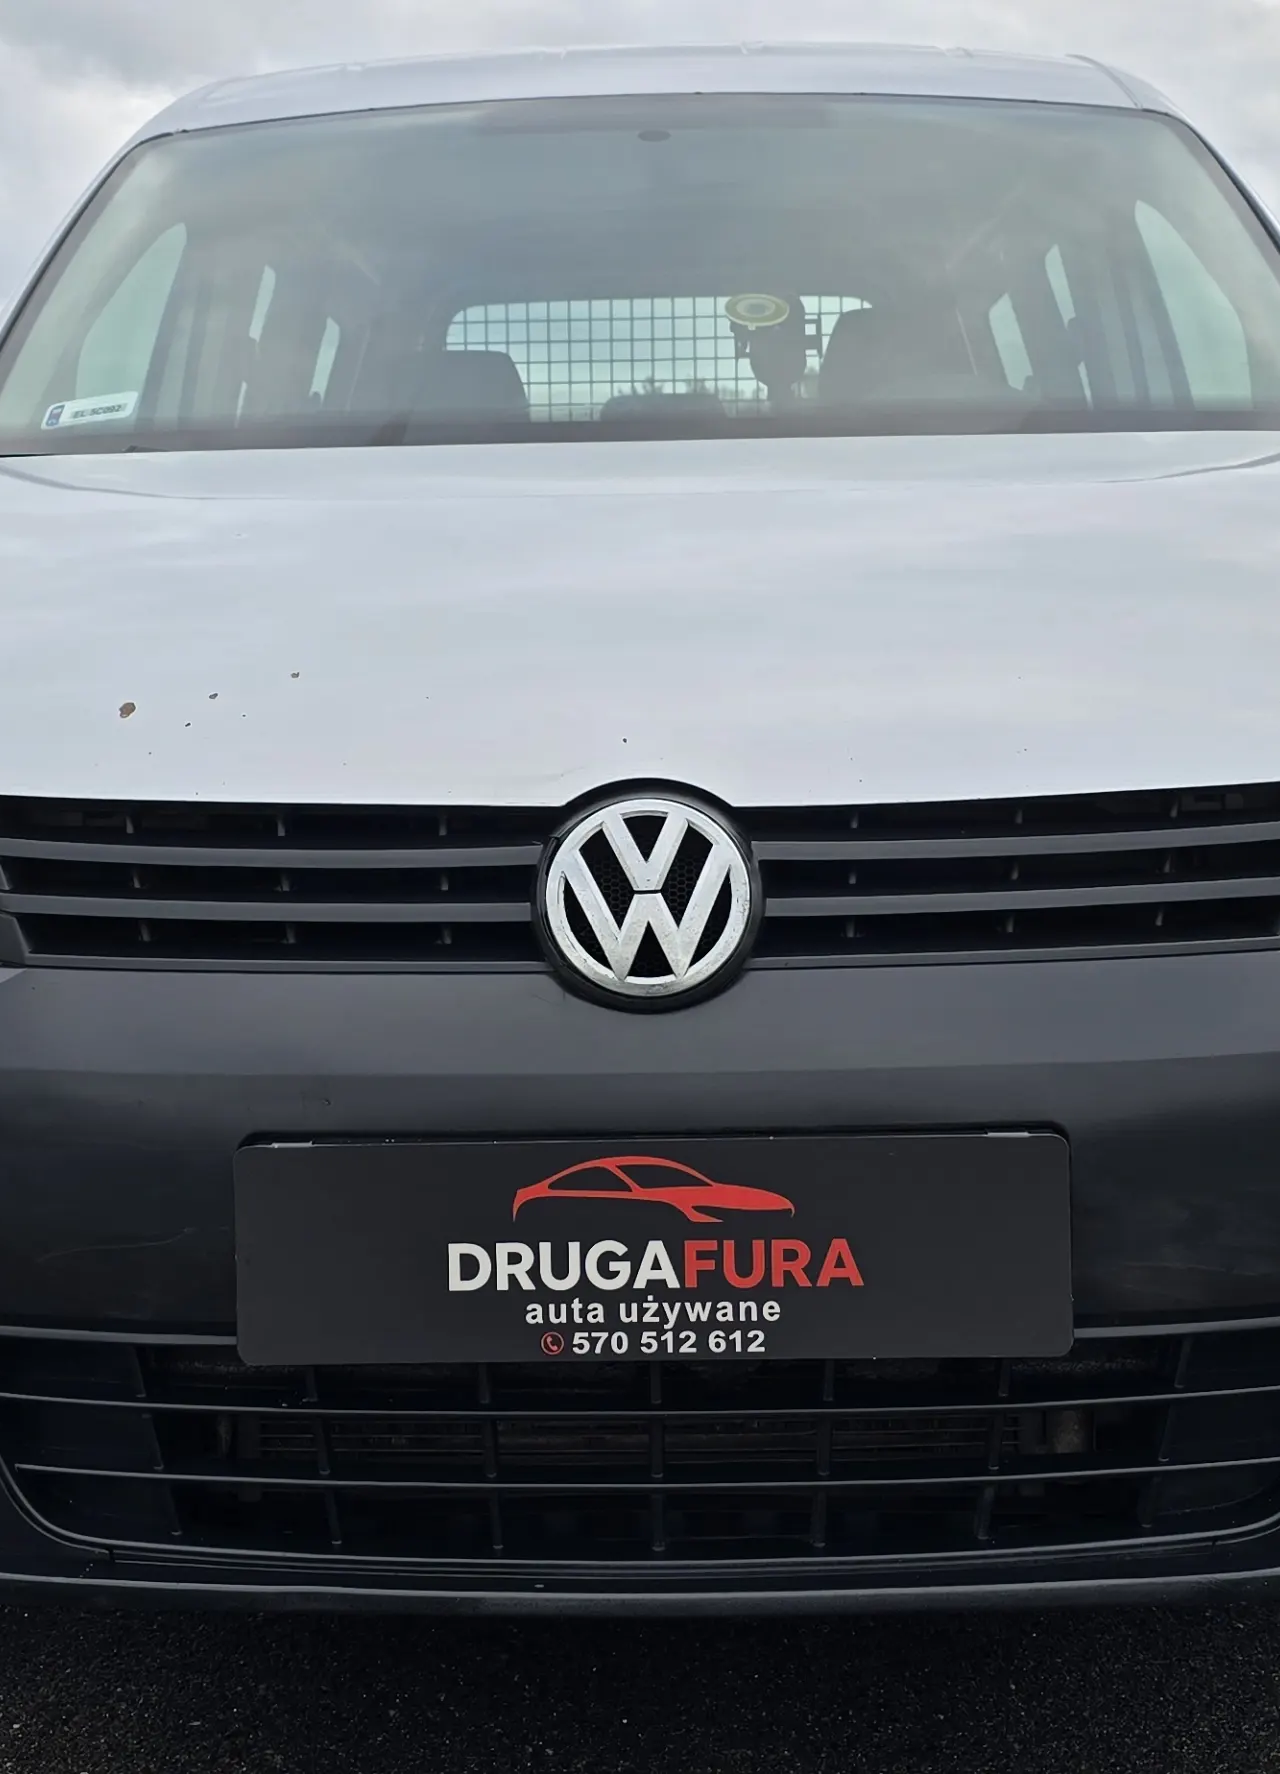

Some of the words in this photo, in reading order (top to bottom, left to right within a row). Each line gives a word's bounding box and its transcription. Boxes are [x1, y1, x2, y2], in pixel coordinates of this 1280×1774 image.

[547, 799, 750, 996] VW
[448, 1238, 864, 1291] DRUGAFURA
[525, 1298, 605, 1325] auta
[619, 1295, 781, 1329] używane
[572, 1332, 628, 1355] 570
[640, 1331, 698, 1354] 512
[708, 1330, 766, 1353] 612
